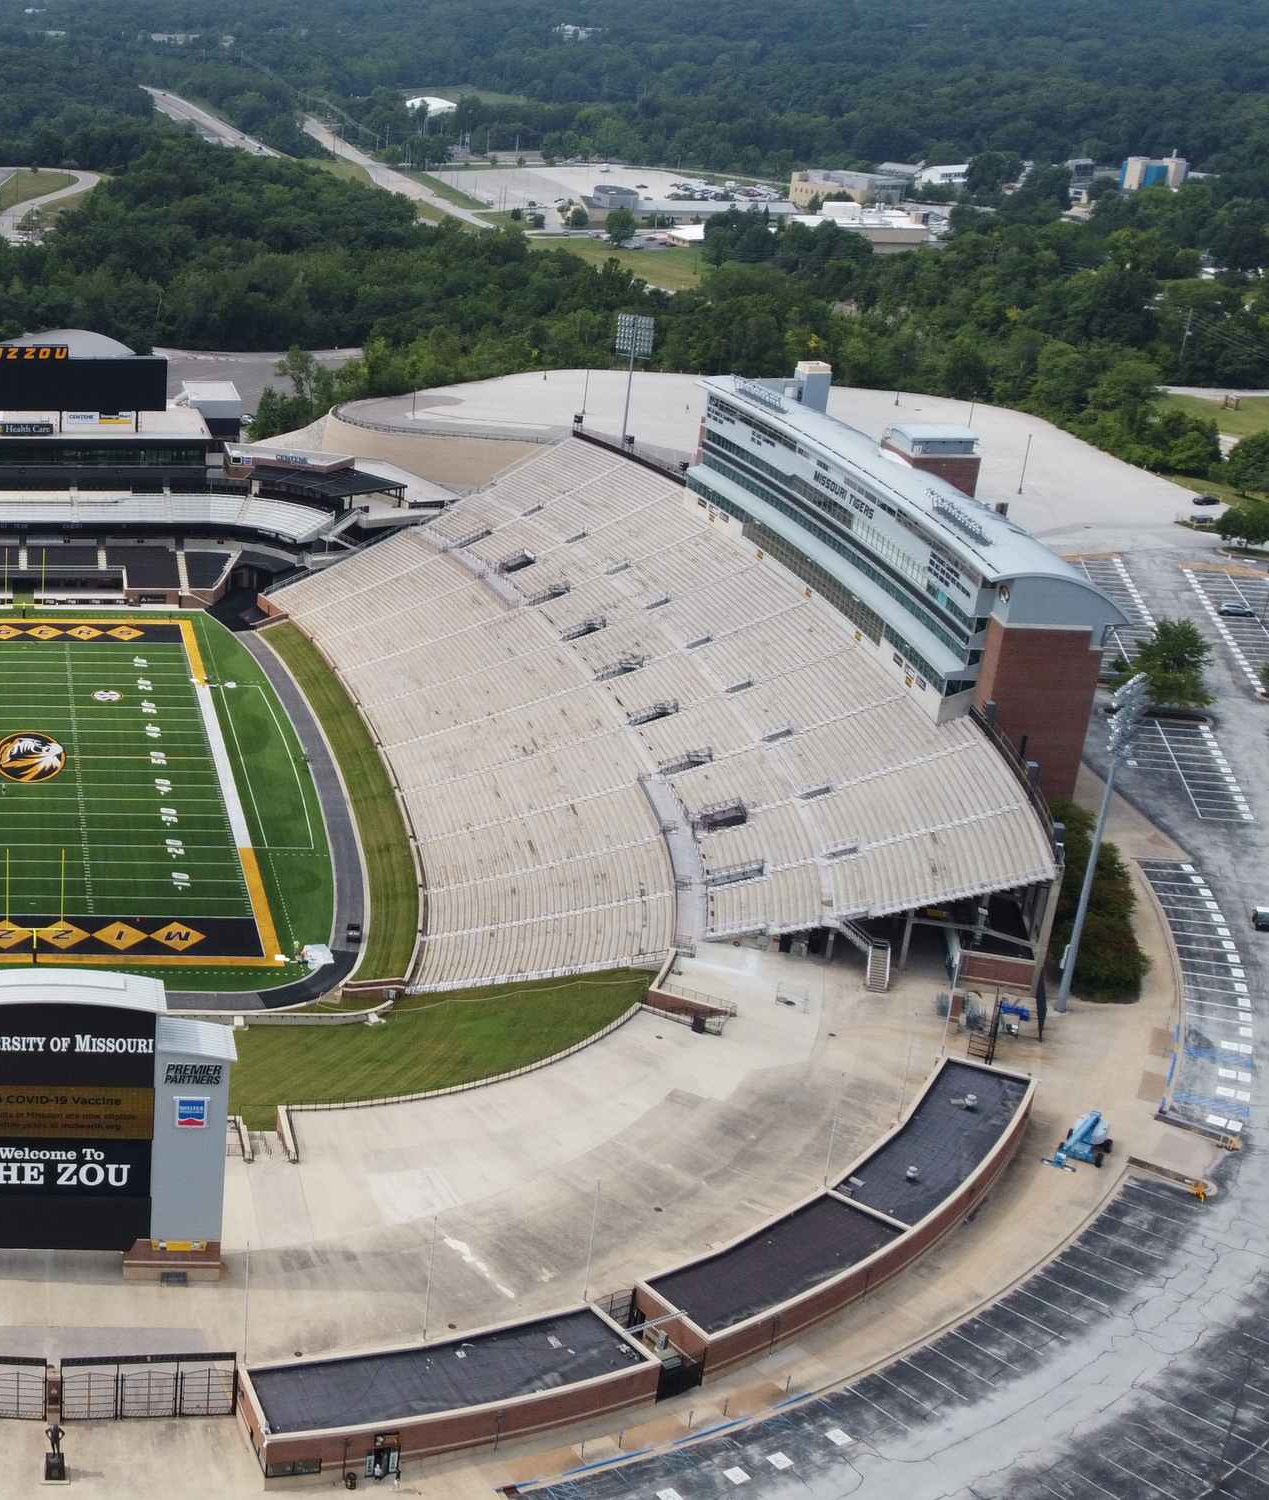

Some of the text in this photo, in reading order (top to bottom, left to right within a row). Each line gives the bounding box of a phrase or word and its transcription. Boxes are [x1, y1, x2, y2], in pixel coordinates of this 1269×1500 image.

[5, 424, 51, 433] Health Care
[813, 470, 875, 520] MISSOURI TIGERS
[165, 839, 185, 855] 20
[171, 872, 190, 887] 10
[166, 1063, 222, 1075] PREMIER
[164, 1075, 221, 1085] PARTNERS
[6, 1095, 122, 1106] COVID-19 Vaccine
[82, 1148, 105, 1161] To
[56, 1163, 131, 1186] ZOU
